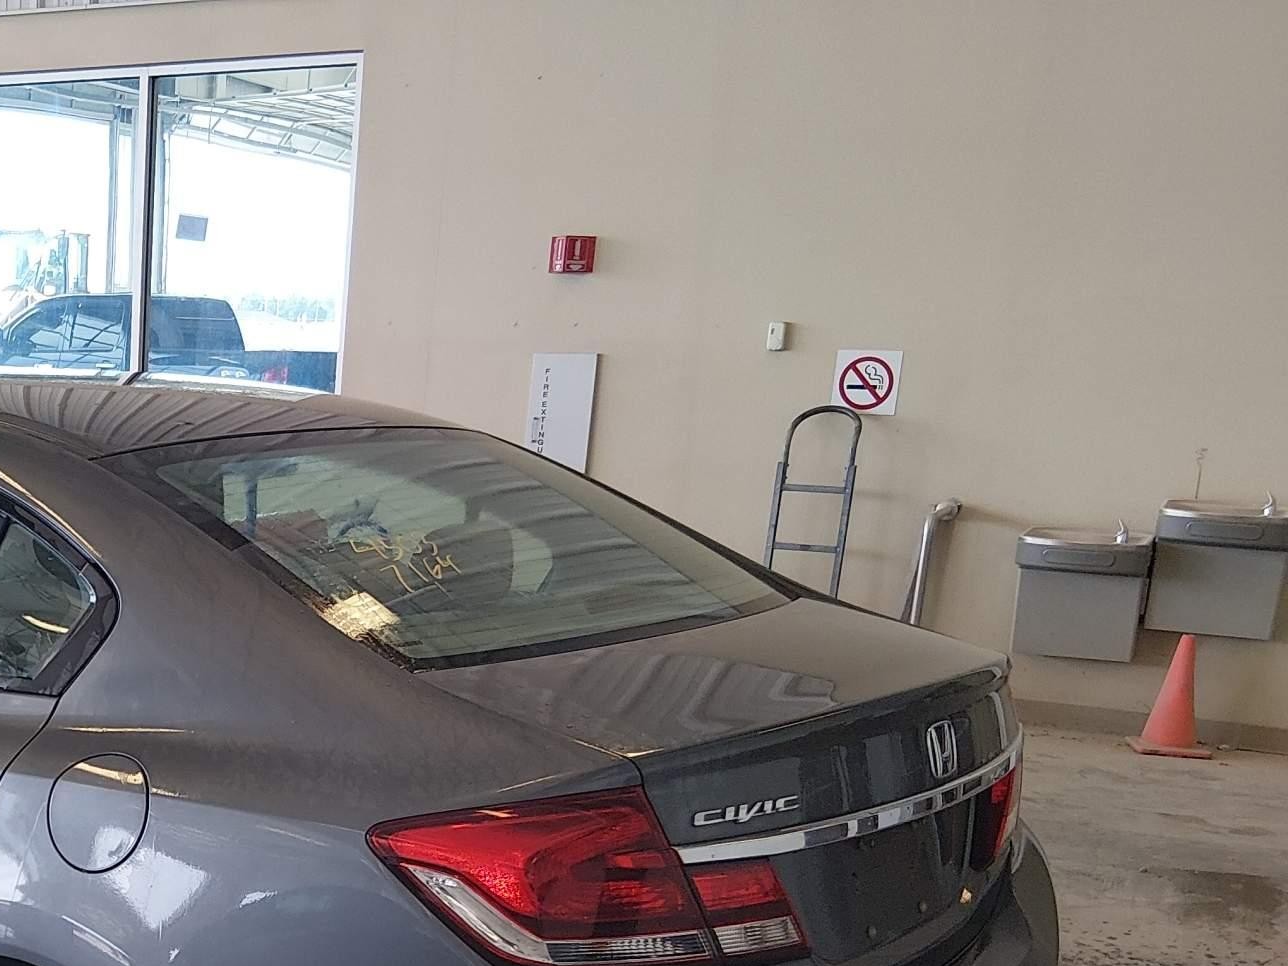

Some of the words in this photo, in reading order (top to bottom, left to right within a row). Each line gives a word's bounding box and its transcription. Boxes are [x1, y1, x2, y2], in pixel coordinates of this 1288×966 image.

[543, 368, 552, 399] FIRE
[379, 554, 463, 593] 7164
[692, 795, 800, 828] CIVIC
